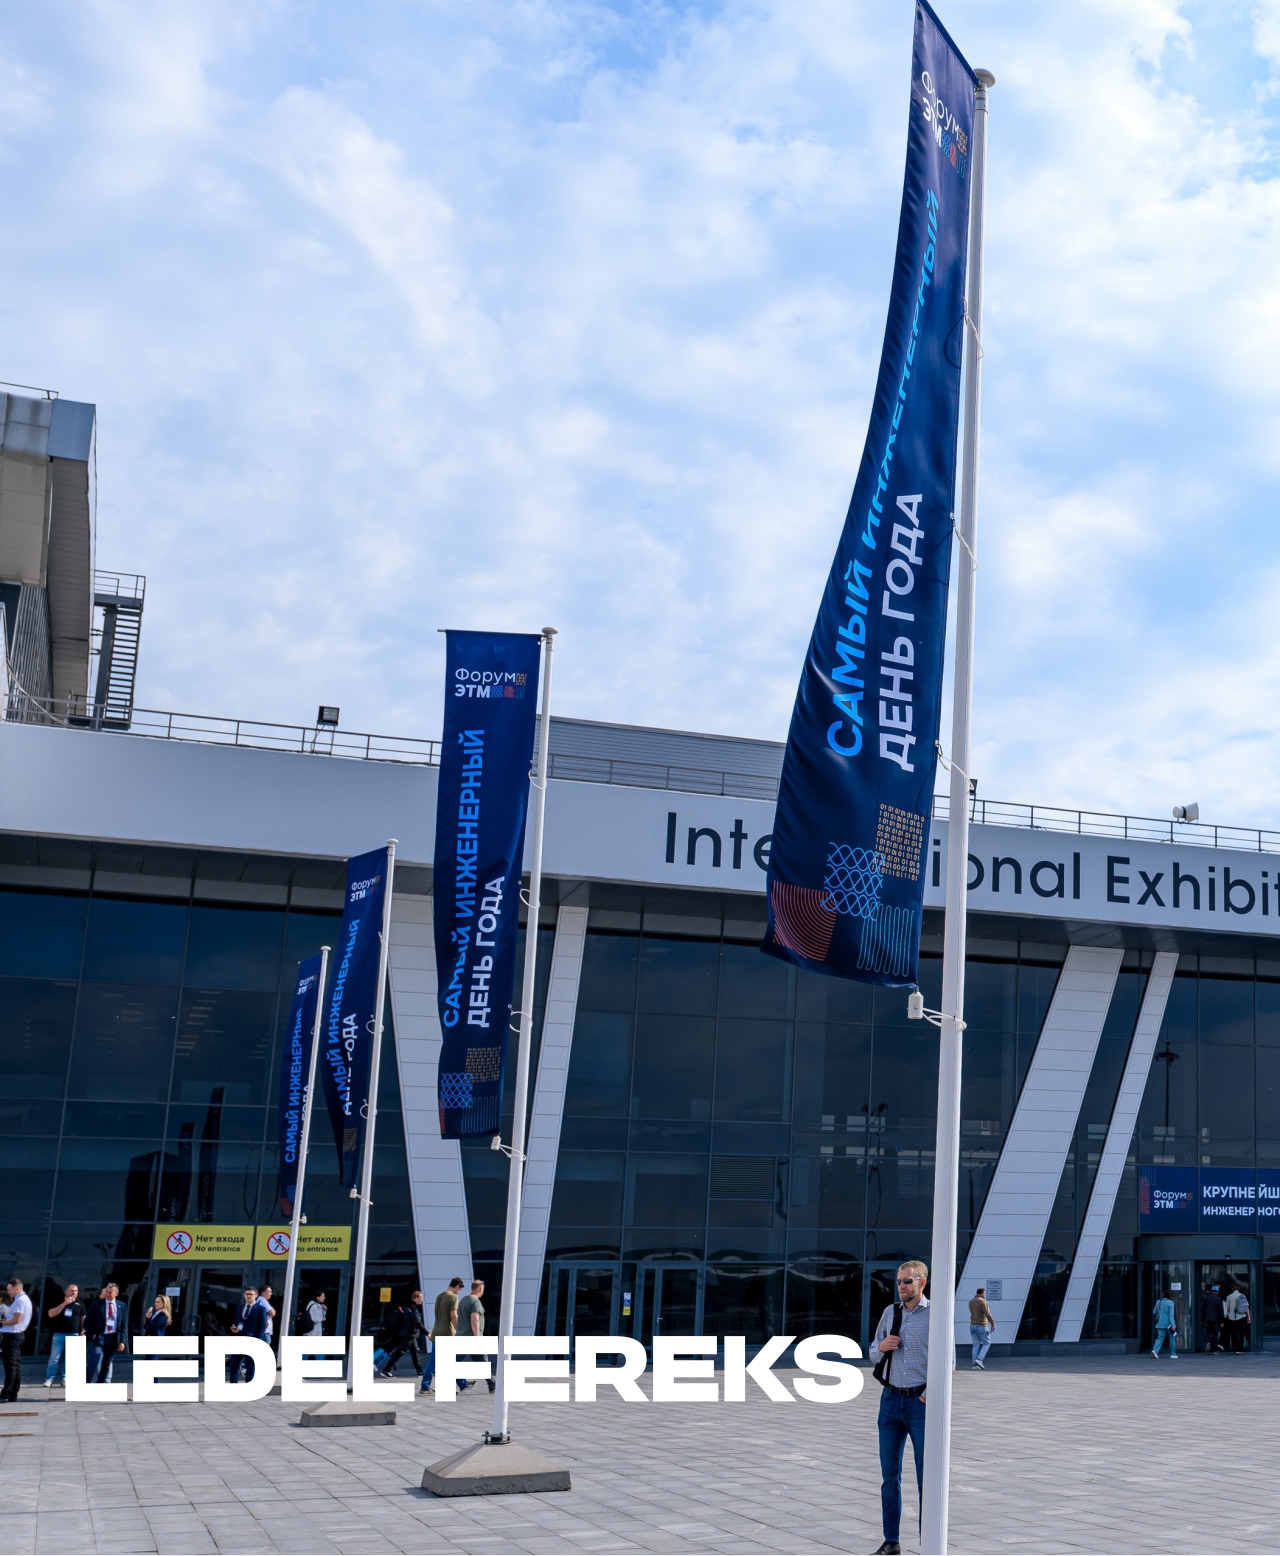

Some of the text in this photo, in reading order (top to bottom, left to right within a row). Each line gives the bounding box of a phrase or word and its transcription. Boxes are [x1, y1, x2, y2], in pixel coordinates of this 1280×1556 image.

[922, 71, 959, 141] Форум
[827, 189, 940, 757] САМЫЙ ИНЖЕНЕРНЫЙ
[881, 493, 924, 622] ГОДА
[455, 668, 516, 685] Форум
[455, 684, 490, 698] ЭТМ
[879, 636, 917, 772] ДЕНЬ
[350, 889, 366, 902] ЭТМ
[443, 729, 485, 1028] САМЫЙ ИНЖЕНЕРНЫЙ
[476, 876, 505, 946] ГОДА
[329, 918, 361, 1044] ИНЖЕНЕРНЫЙ
[467, 955, 493, 1028] ДЕНЬ
[285, 1109, 299, 1163] САМЫЙ
[1153, 1190, 1187, 1200] Форум
[1153, 1200, 1174, 1209] ЭТМ
[196, 1234, 245, 1244] Нет входа
[314, 1236, 342, 1244] входа
